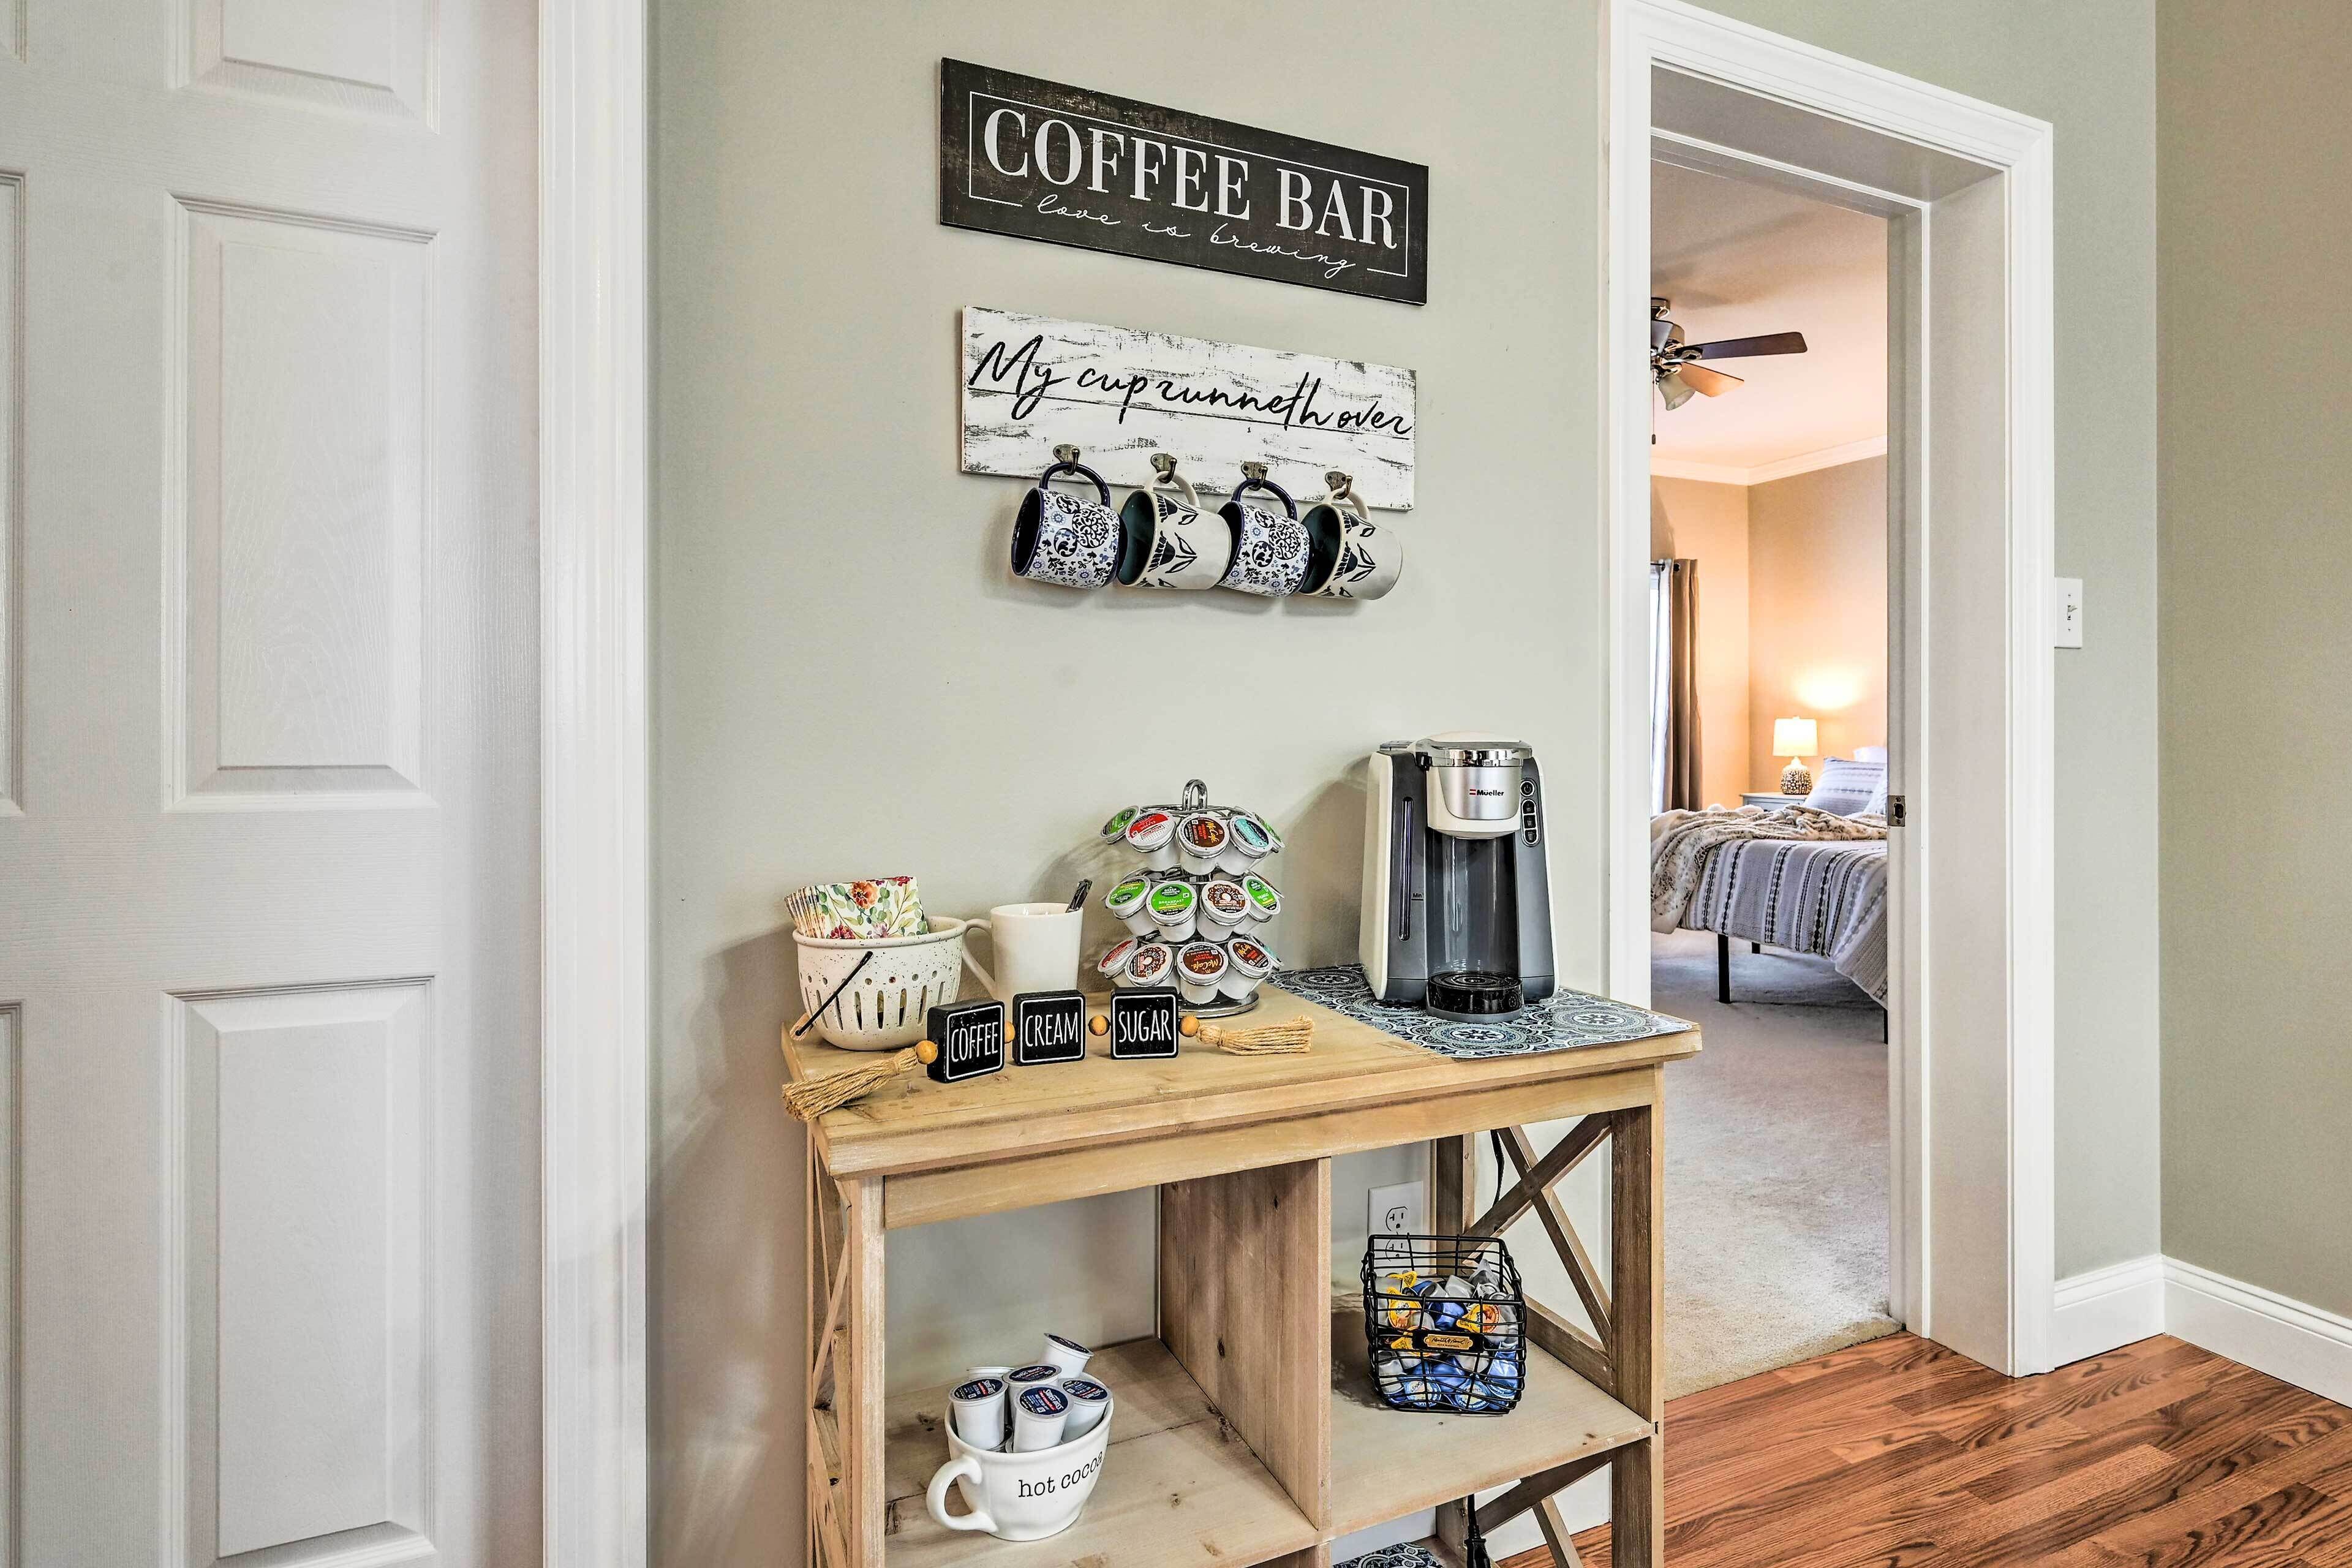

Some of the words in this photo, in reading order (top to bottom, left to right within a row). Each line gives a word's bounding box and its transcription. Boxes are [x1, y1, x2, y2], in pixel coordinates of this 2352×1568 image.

[984, 108, 1250, 220] COFFEE
[1276, 168, 1398, 249] BAR
[1038, 194, 1121, 225] love
[1141, 220, 1191, 238] is
[1210, 222, 1356, 279] brewing
[968, 334, 1071, 421] My
[1077, 366, 1149, 425] cup
[1156, 371, 1334, 431] runneth
[1337, 401, 1412, 435] over
[951, 1022, 998, 1063] COFFEE
[1025, 1012, 1078, 1047] CREAM
[1118, 1009, 1172, 1043] SUGAR
[1018, 1477, 1055, 1498] hot
[1061, 1451, 1102, 1488] cocoa
